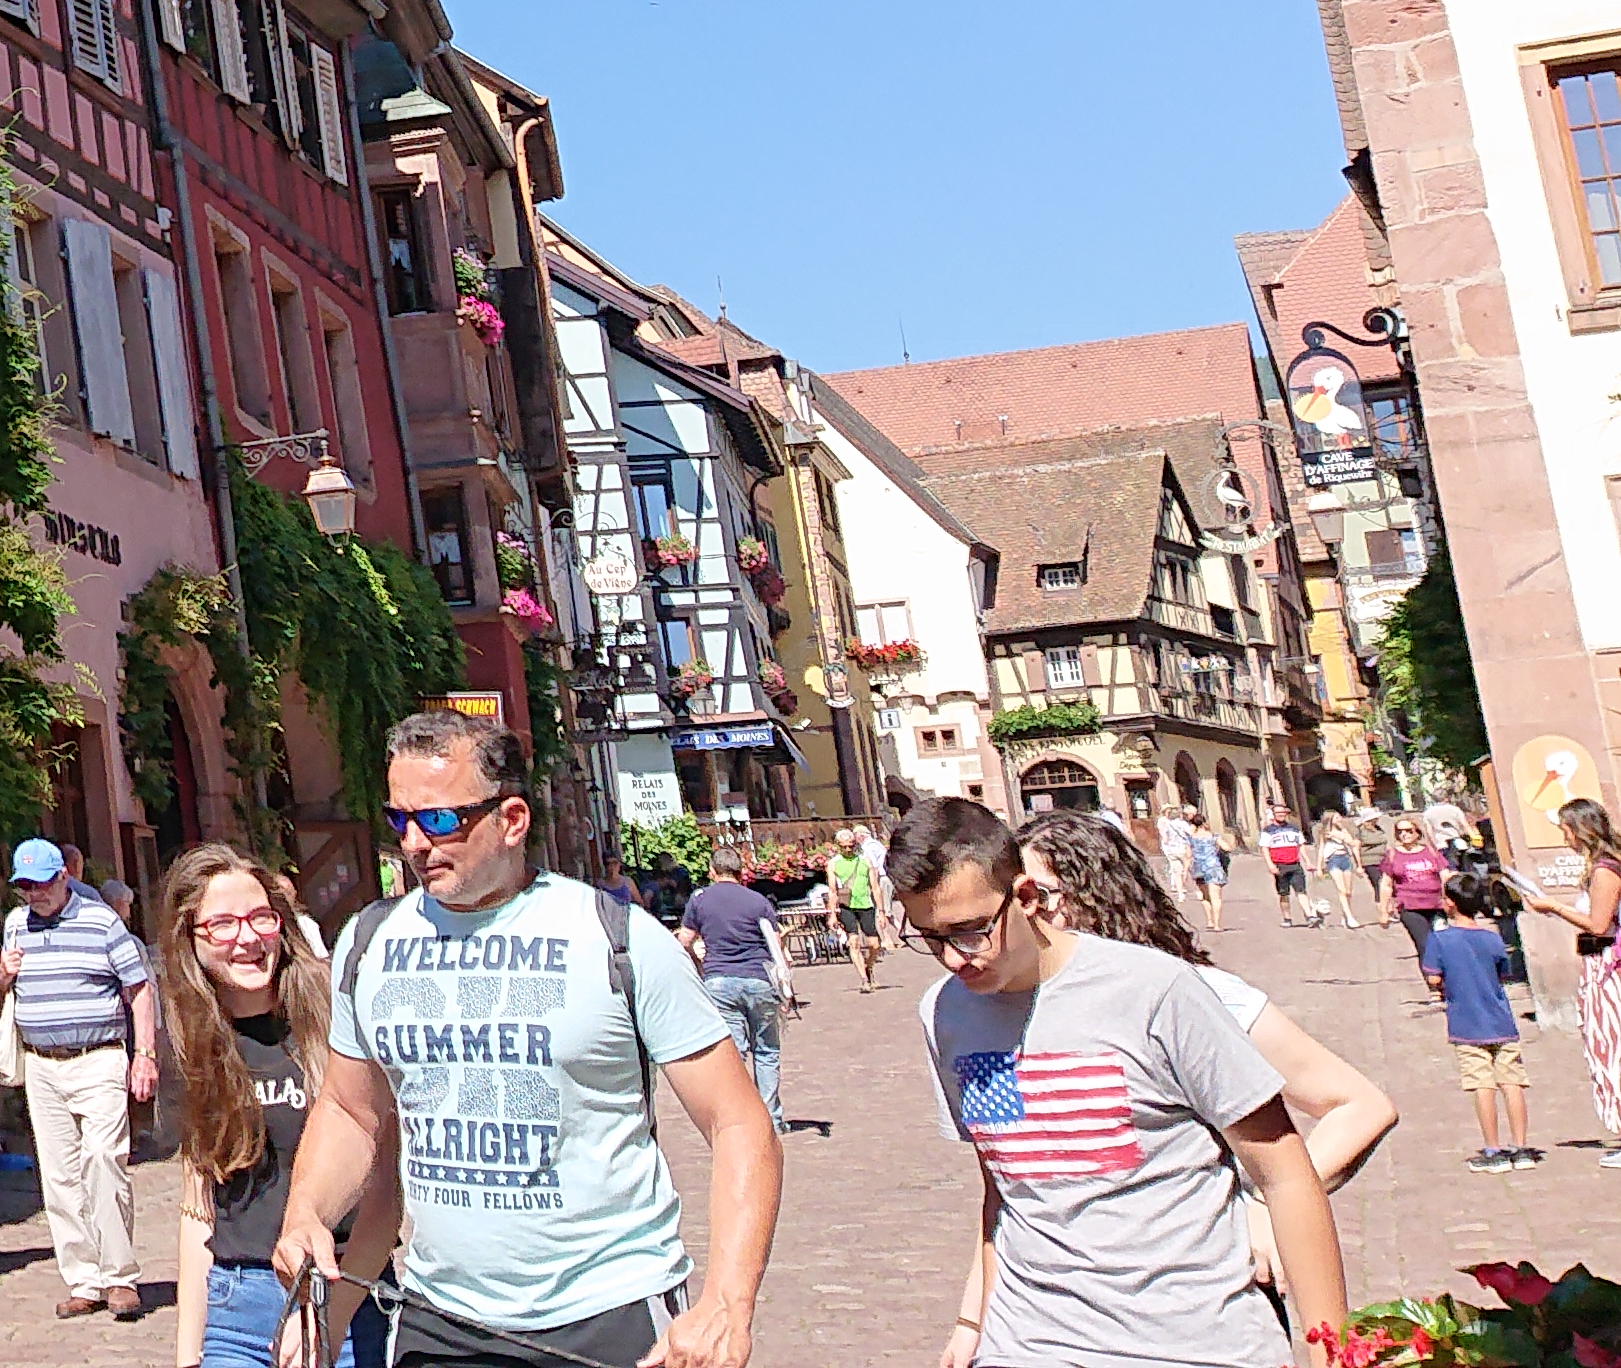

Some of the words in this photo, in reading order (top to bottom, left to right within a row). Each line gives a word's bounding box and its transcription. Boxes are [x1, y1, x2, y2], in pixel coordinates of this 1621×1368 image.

[1321, 451, 1354, 464] CAVE
[1304, 458, 1376, 477] D'AFFINAGE
[588, 565, 603, 575] Au
[606, 563, 627, 576] Cep
[590, 579, 602, 588] de
[603, 577, 633, 590] Vigne
[731, 732, 770, 744] MOINES
[631, 779, 664, 789] RELAIS
[633, 800, 668, 812] MOINES
[382, 934, 570, 974] WELCOME
[375, 1023, 554, 1067] SUMMER
[433, 1186, 472, 1208] FOUR
[483, 1191, 564, 1211] FELLOWS
